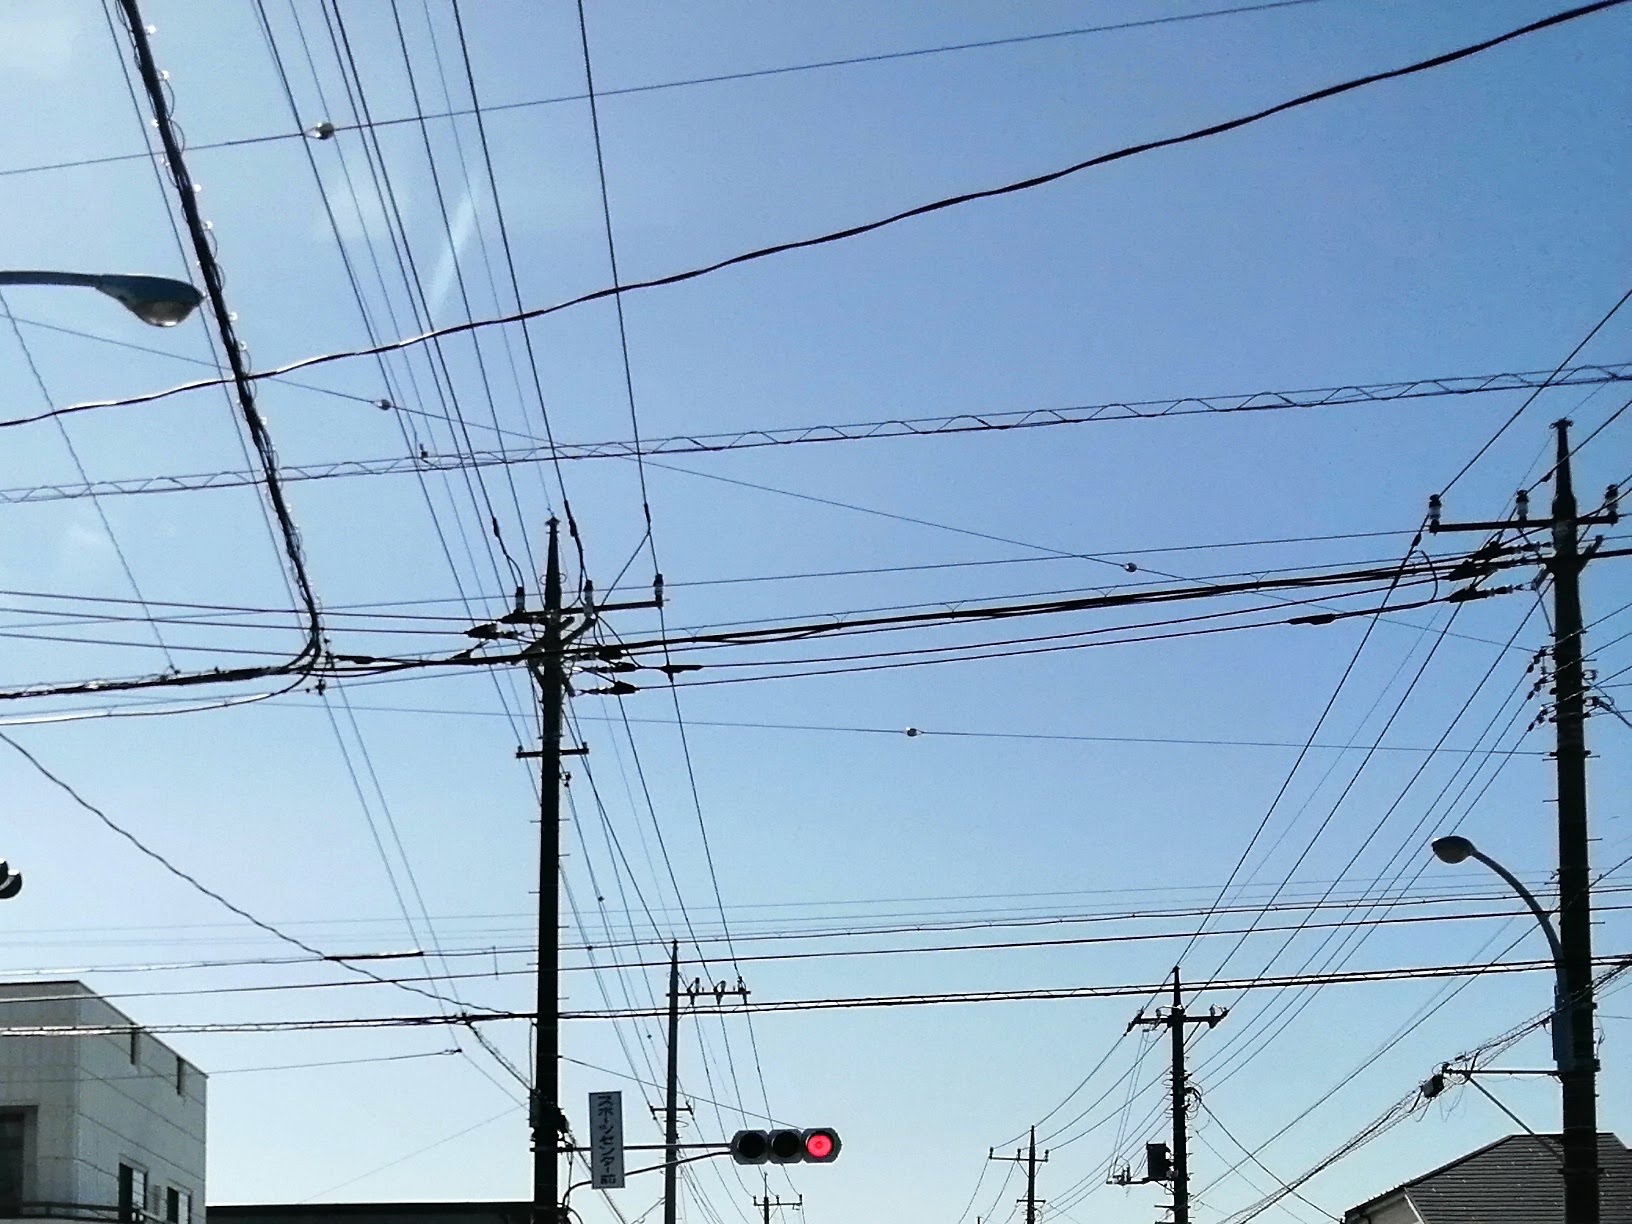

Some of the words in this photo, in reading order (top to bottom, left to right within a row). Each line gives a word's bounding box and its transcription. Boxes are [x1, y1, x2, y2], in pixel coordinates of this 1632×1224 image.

[597, 1095, 617, 1185] スポーツセンター前
